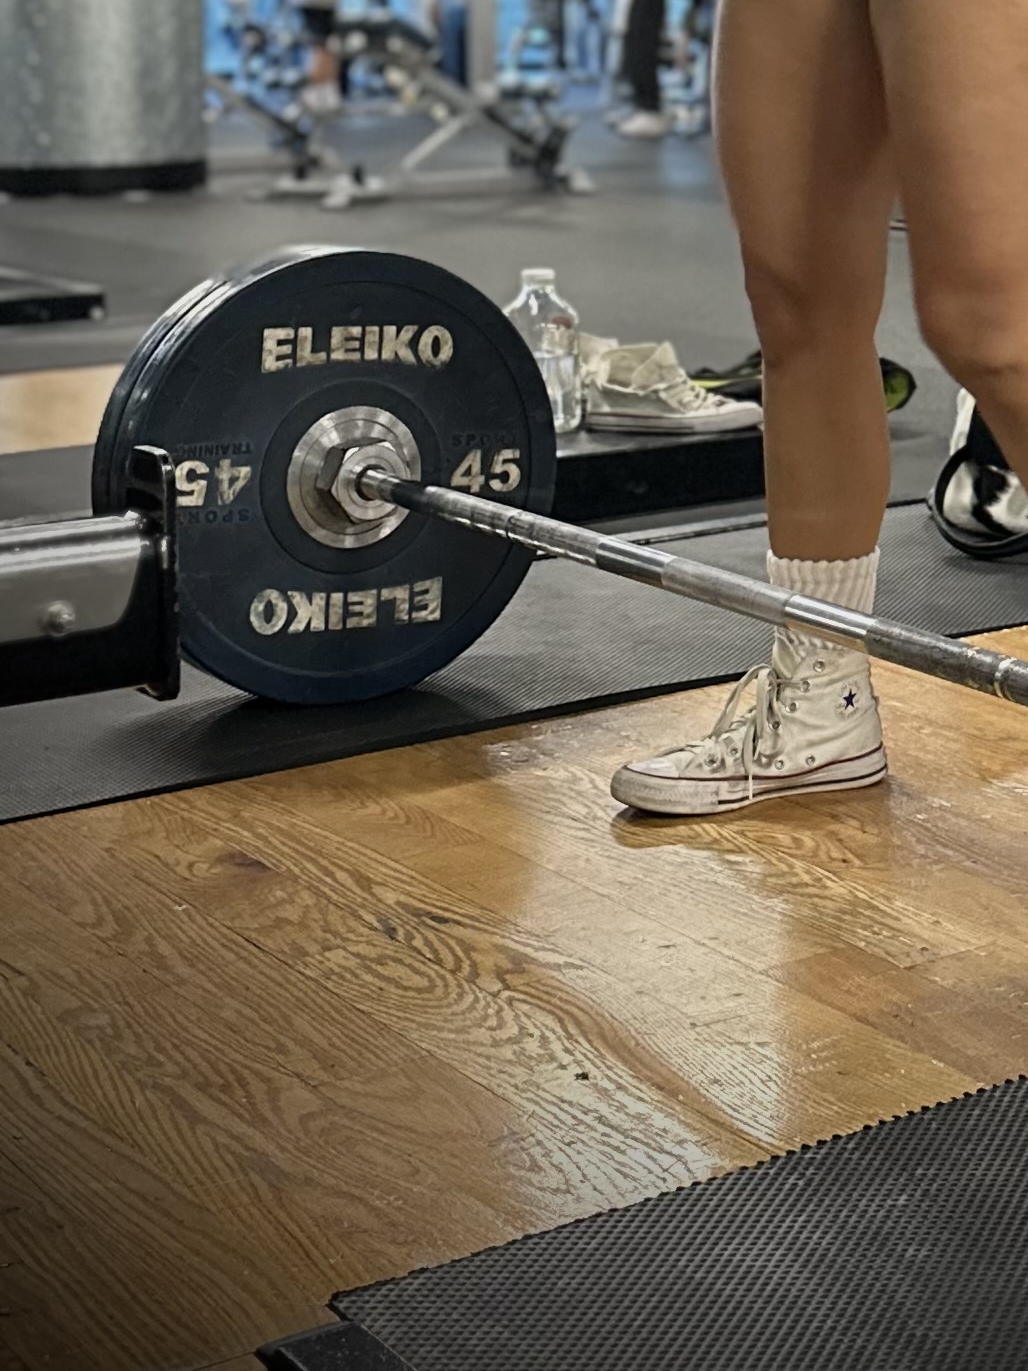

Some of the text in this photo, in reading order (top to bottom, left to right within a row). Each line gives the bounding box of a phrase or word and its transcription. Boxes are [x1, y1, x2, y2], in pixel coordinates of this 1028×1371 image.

[261, 325, 454, 374] ELEIKO
[174, 459, 252, 507] 45
[450, 448, 521, 494] 45
[250, 576, 443, 636] ELEIKO
